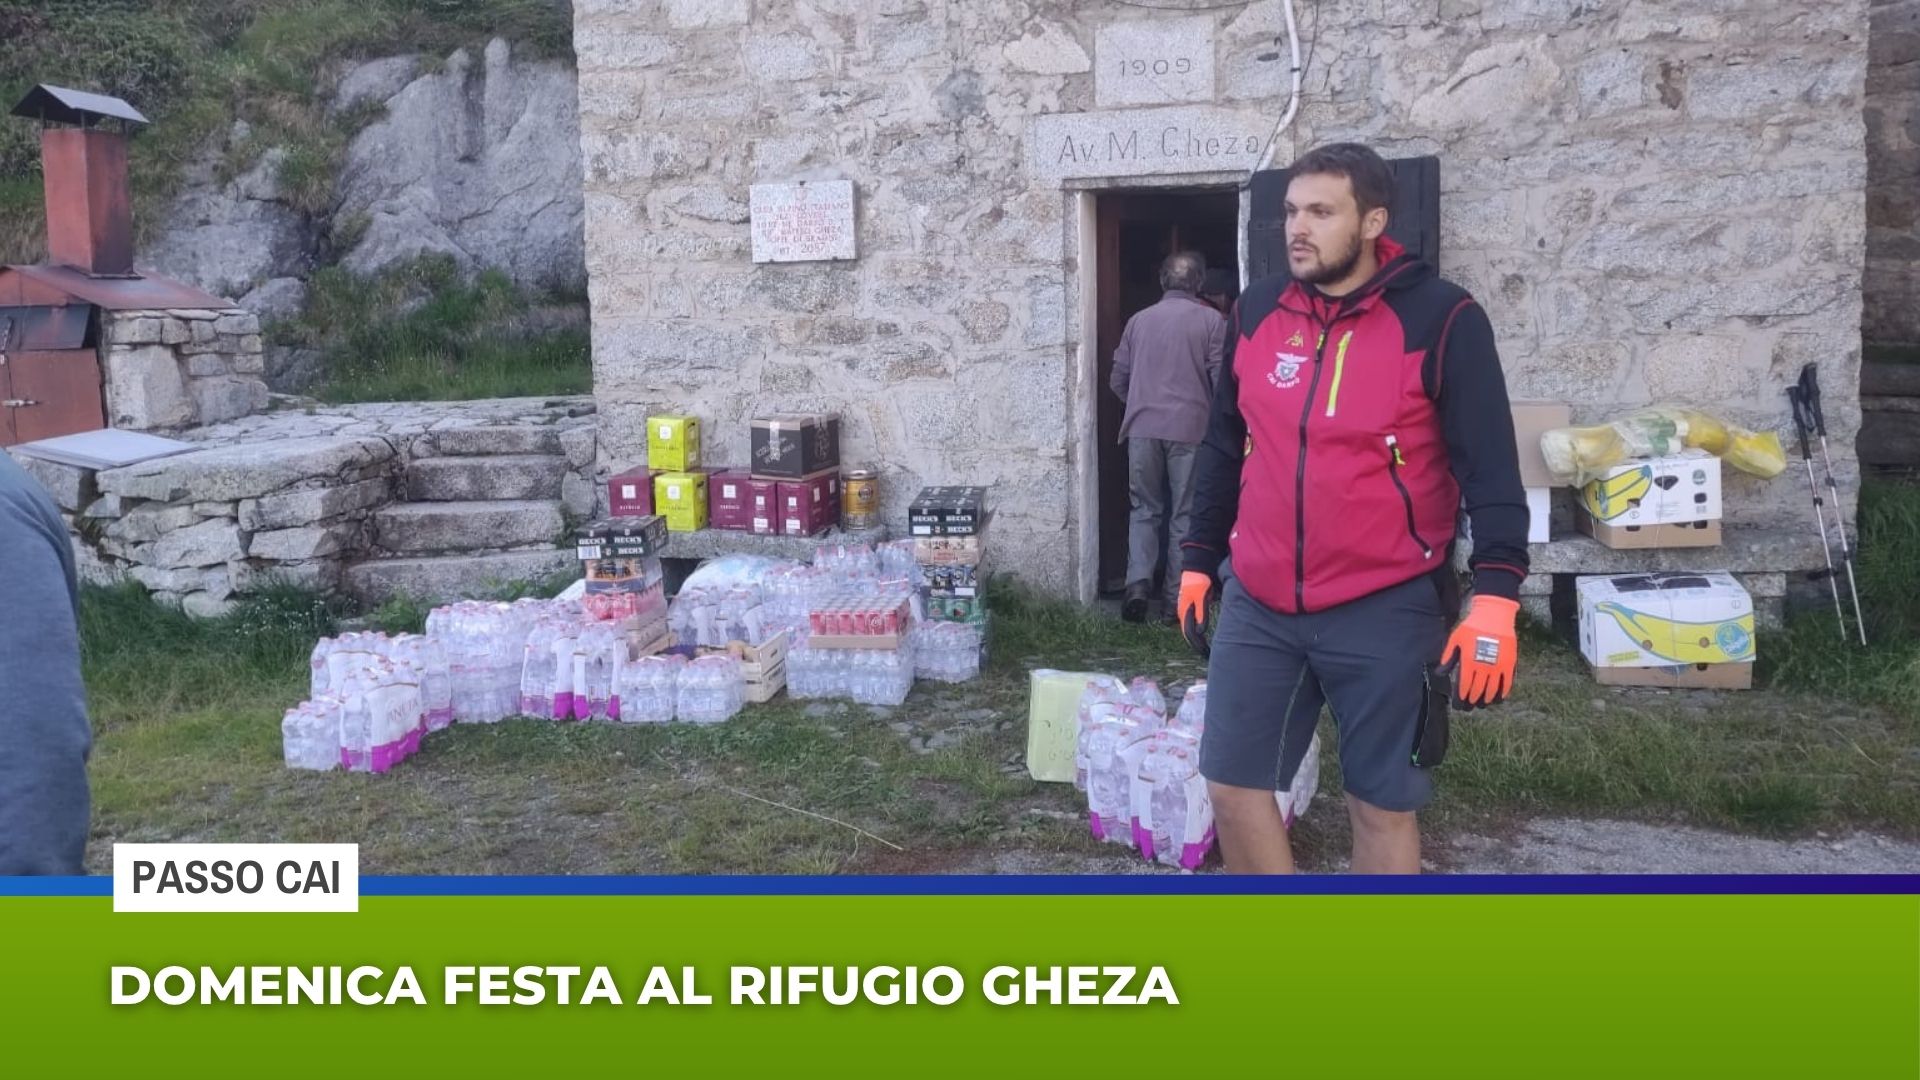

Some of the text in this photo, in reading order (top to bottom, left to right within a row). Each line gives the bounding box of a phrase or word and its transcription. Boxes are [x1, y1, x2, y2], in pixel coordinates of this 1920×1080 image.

[1119, 58, 1191, 77] 1909
[1058, 135, 1098, 163] Av.
[1108, 130, 1146, 161] M.
